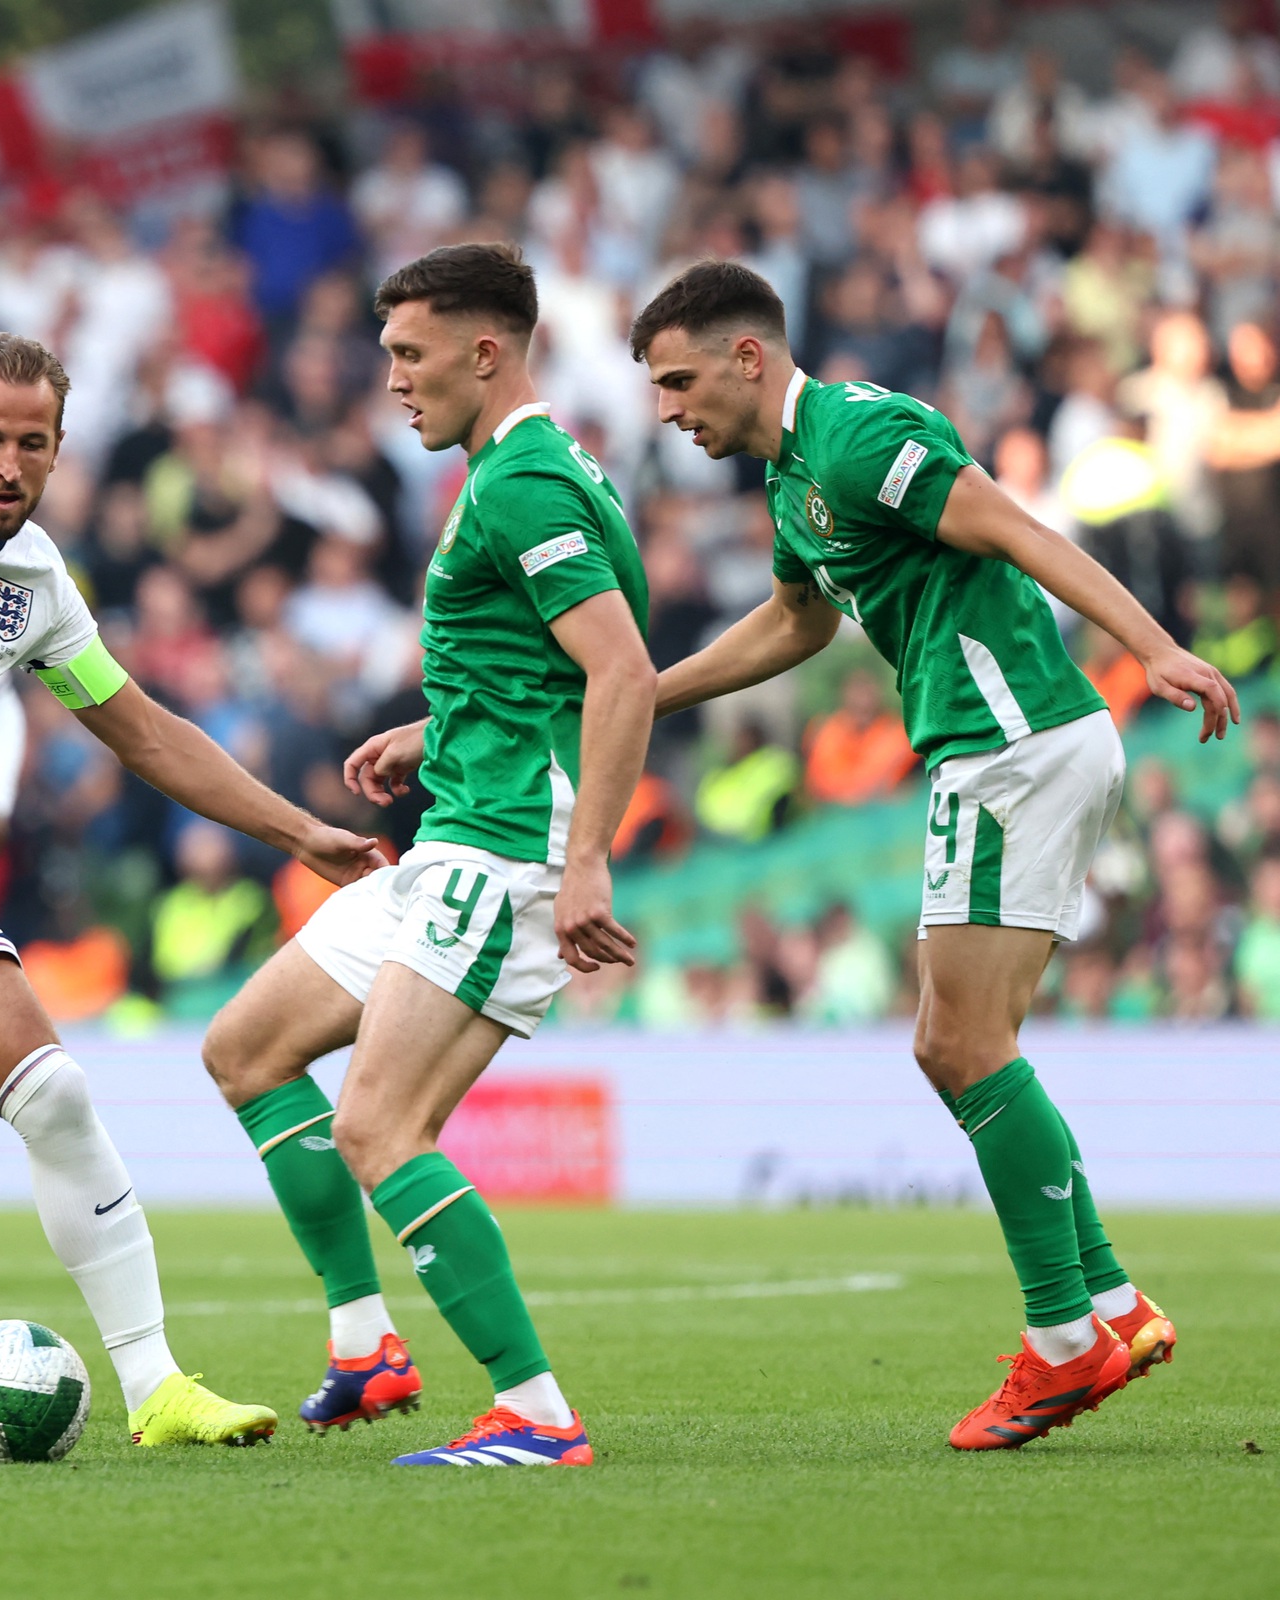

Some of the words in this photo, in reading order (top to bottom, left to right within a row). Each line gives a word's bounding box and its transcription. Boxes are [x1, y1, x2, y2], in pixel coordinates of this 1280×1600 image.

[885, 444, 921, 504] FOUNDATION
[523, 539, 584, 569] FOUNDATION
[930, 792, 960, 864] 4
[442, 868, 489, 937] 4
[416, 939, 448, 960] CASTORE
